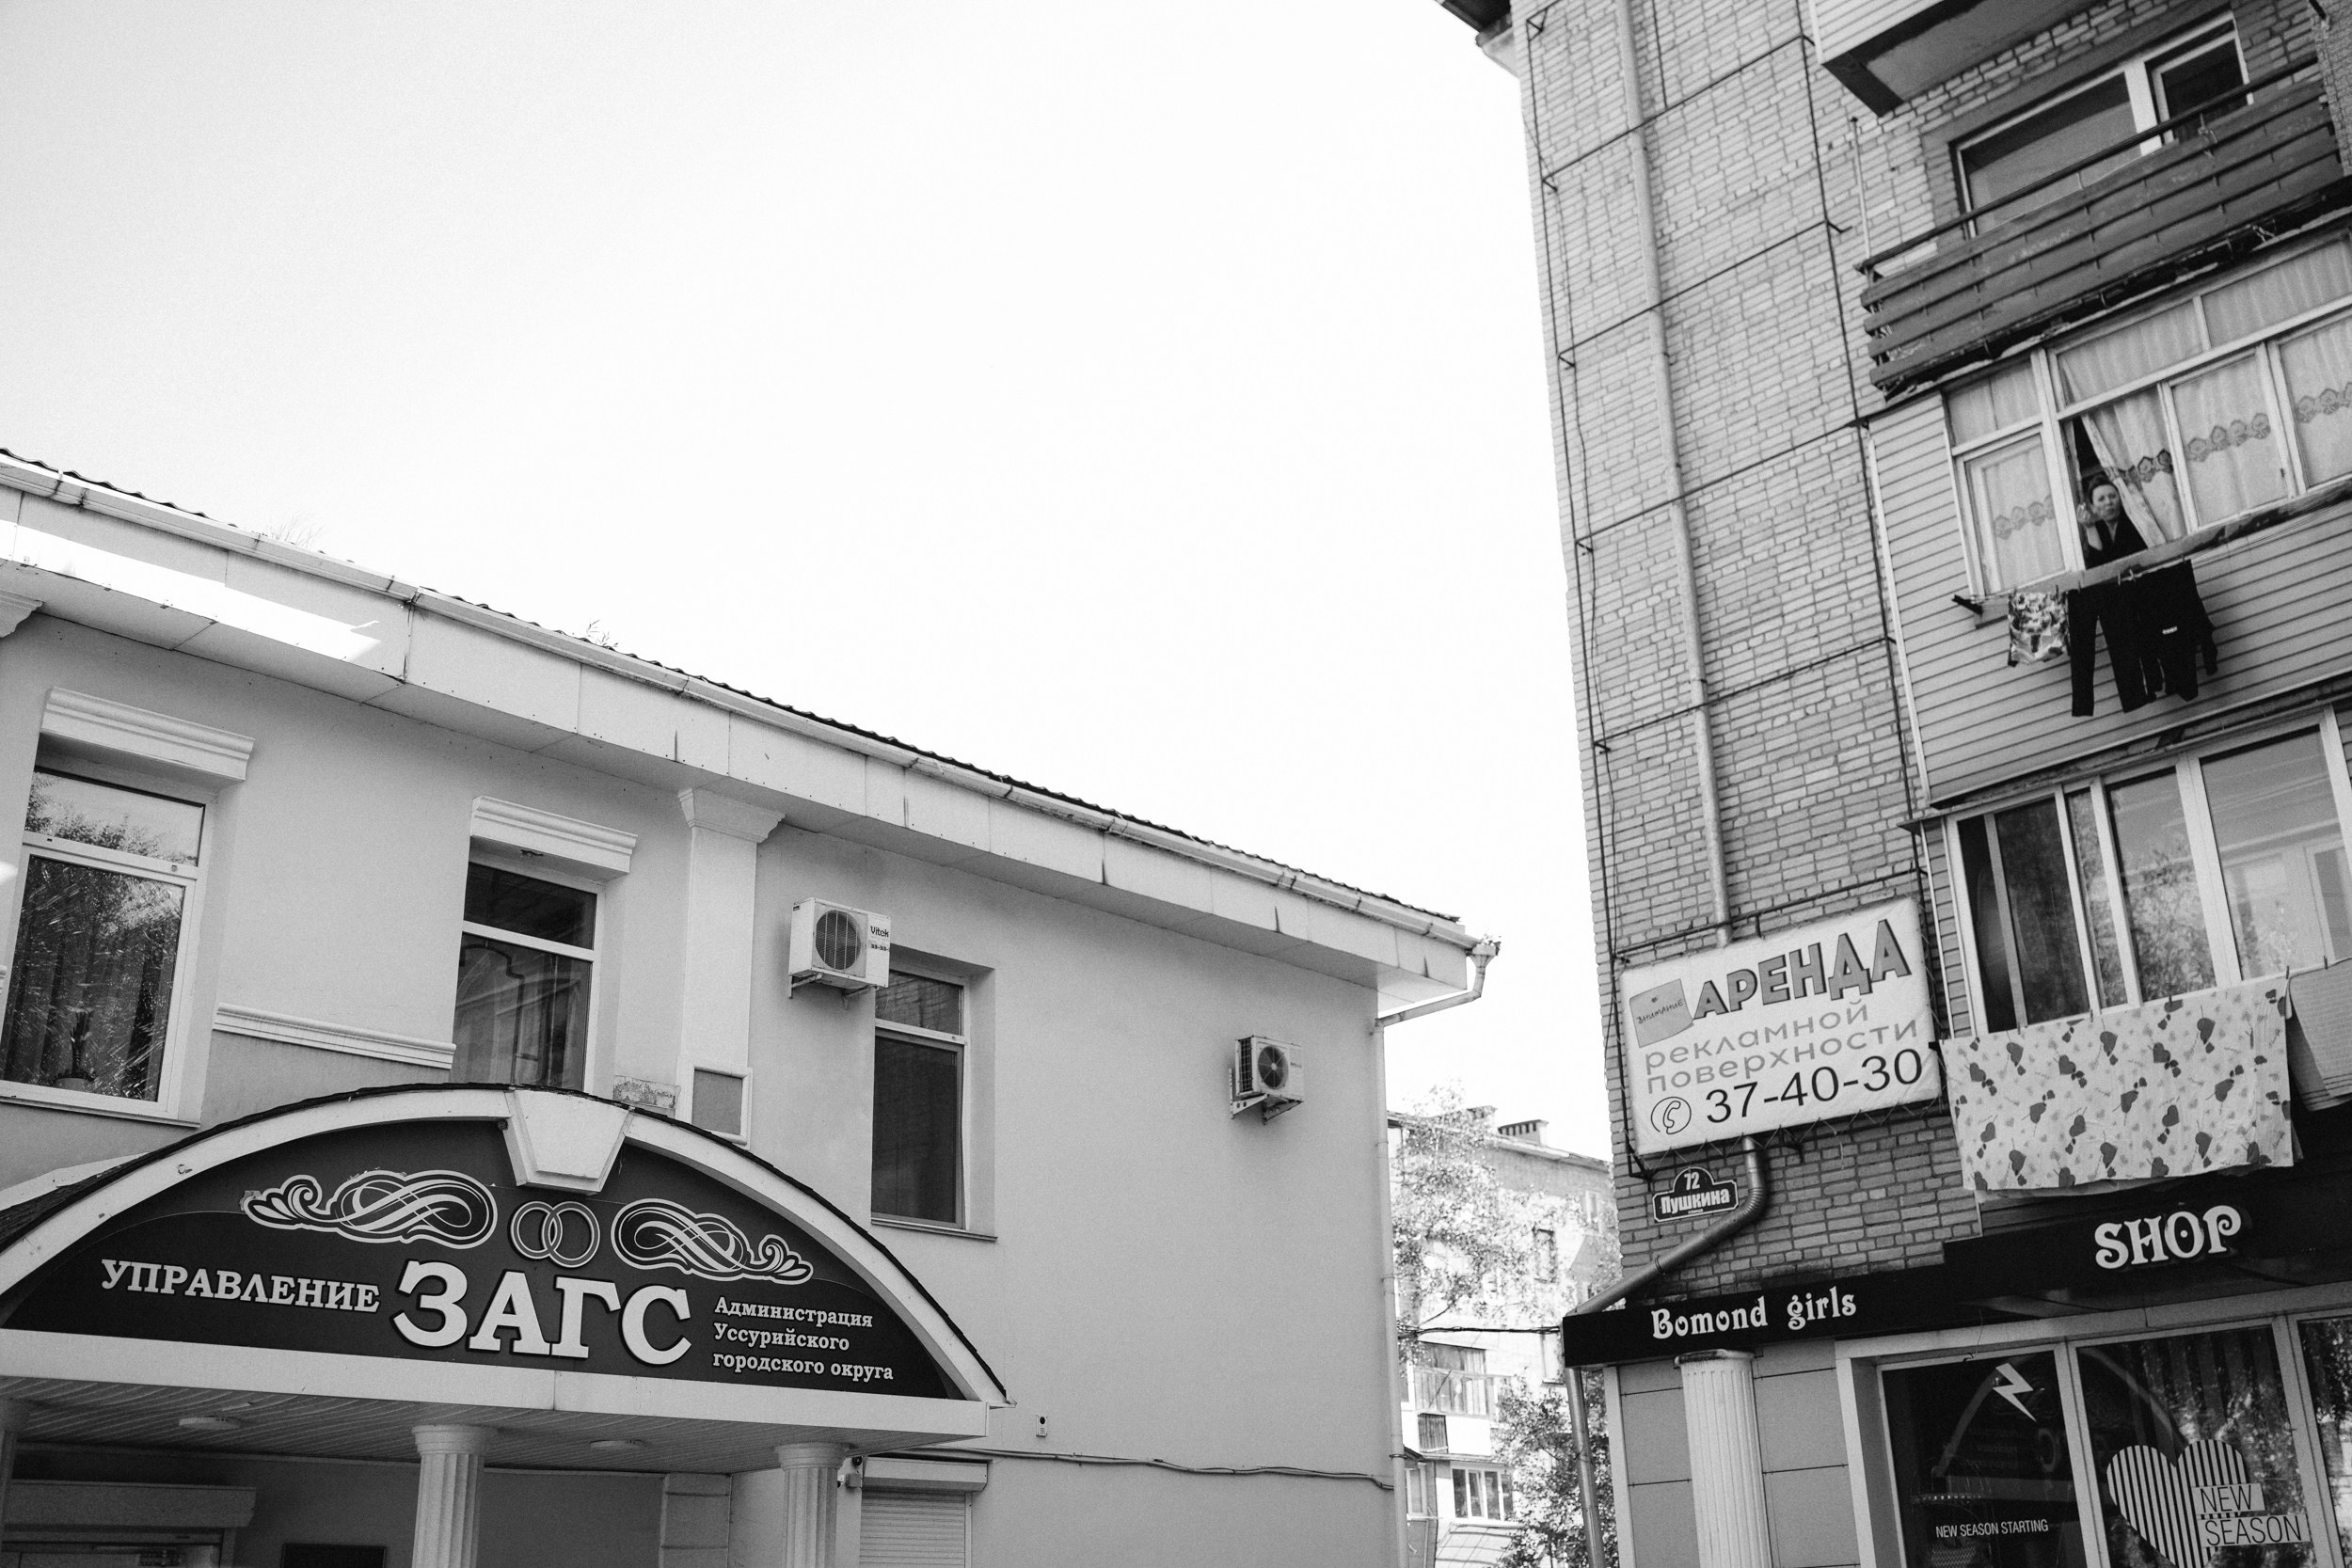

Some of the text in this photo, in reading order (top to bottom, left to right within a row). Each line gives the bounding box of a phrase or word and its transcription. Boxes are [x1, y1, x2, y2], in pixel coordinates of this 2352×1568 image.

[870, 926, 889, 938] Vitek
[1693, 919, 1912, 1020] АРЕНДА
[1636, 998, 1684, 1024] ВНИМАНИЕ
[1645, 999, 1868, 1075] рекламной
[1647, 1020, 1917, 1094] поверхности
[1705, 1049, 1923, 1123] 37-40-30
[1684, 1171, 1700, 1191] 72
[1661, 1188, 1730, 1214] Пушкина
[2094, 1205, 2241, 1269] SHOP
[101, 1259, 691, 1365] УПРАВЛЕНИЕ ЗАГС
[714, 1296, 873, 1327] Администрация
[1651, 1286, 1856, 1339] Bomond girls
[713, 1323, 850, 1351] Уссурийского
[713, 1353, 894, 1383] городского округа
[2201, 1484, 2251, 1513] NEW
[1936, 1519, 2048, 1538] NEW SEASON STARTING
[2205, 1515, 2302, 1546] SEASON
